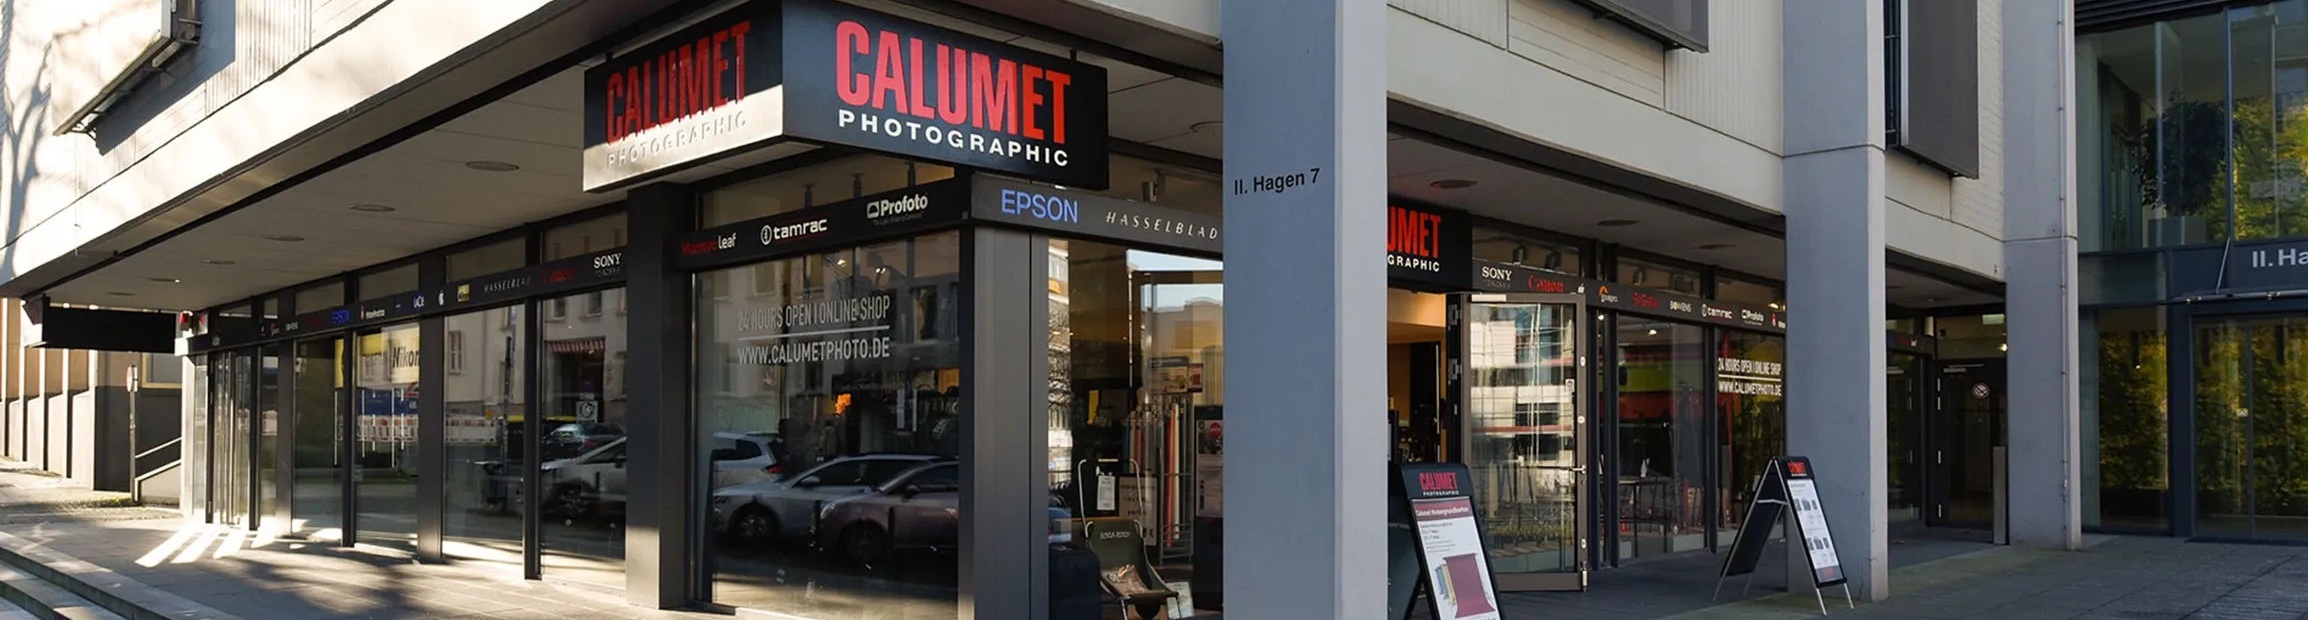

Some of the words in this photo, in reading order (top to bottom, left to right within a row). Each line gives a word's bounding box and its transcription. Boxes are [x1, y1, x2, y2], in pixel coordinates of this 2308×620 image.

[606, 20, 751, 146] CALUMET
[835, 20, 1071, 144] CALUMET
[607, 110, 746, 169] PHOTOGRAPHIC
[838, 109, 1069, 168] PHOTOGRAPHIC
[1234, 179, 1248, 195] II.
[1253, 174, 1305, 194] Hagen
[1310, 167, 1320, 183] 7
[880, 193, 928, 217] Profoto
[1001, 188, 1078, 224] EPSON
[774, 218, 828, 240] tamrac
[1105, 210, 1219, 240] HASSELBLAD
[718, 232, 737, 250] leaf
[593, 253, 622, 270] SONY
[2252, 250, 2274, 268] II.
[1482, 266, 1512, 281] SONY
[1528, 275, 1565, 293] Canon
[750, 306, 784, 330] HOURS
[785, 303, 812, 327] OPEN
[820, 299, 858, 323] ONLINE
[860, 295, 891, 320] SHOP
[738, 337, 890, 366] WWW.CALUMETPHOTO.DE
[1419, 472, 1458, 490] CALUMET
